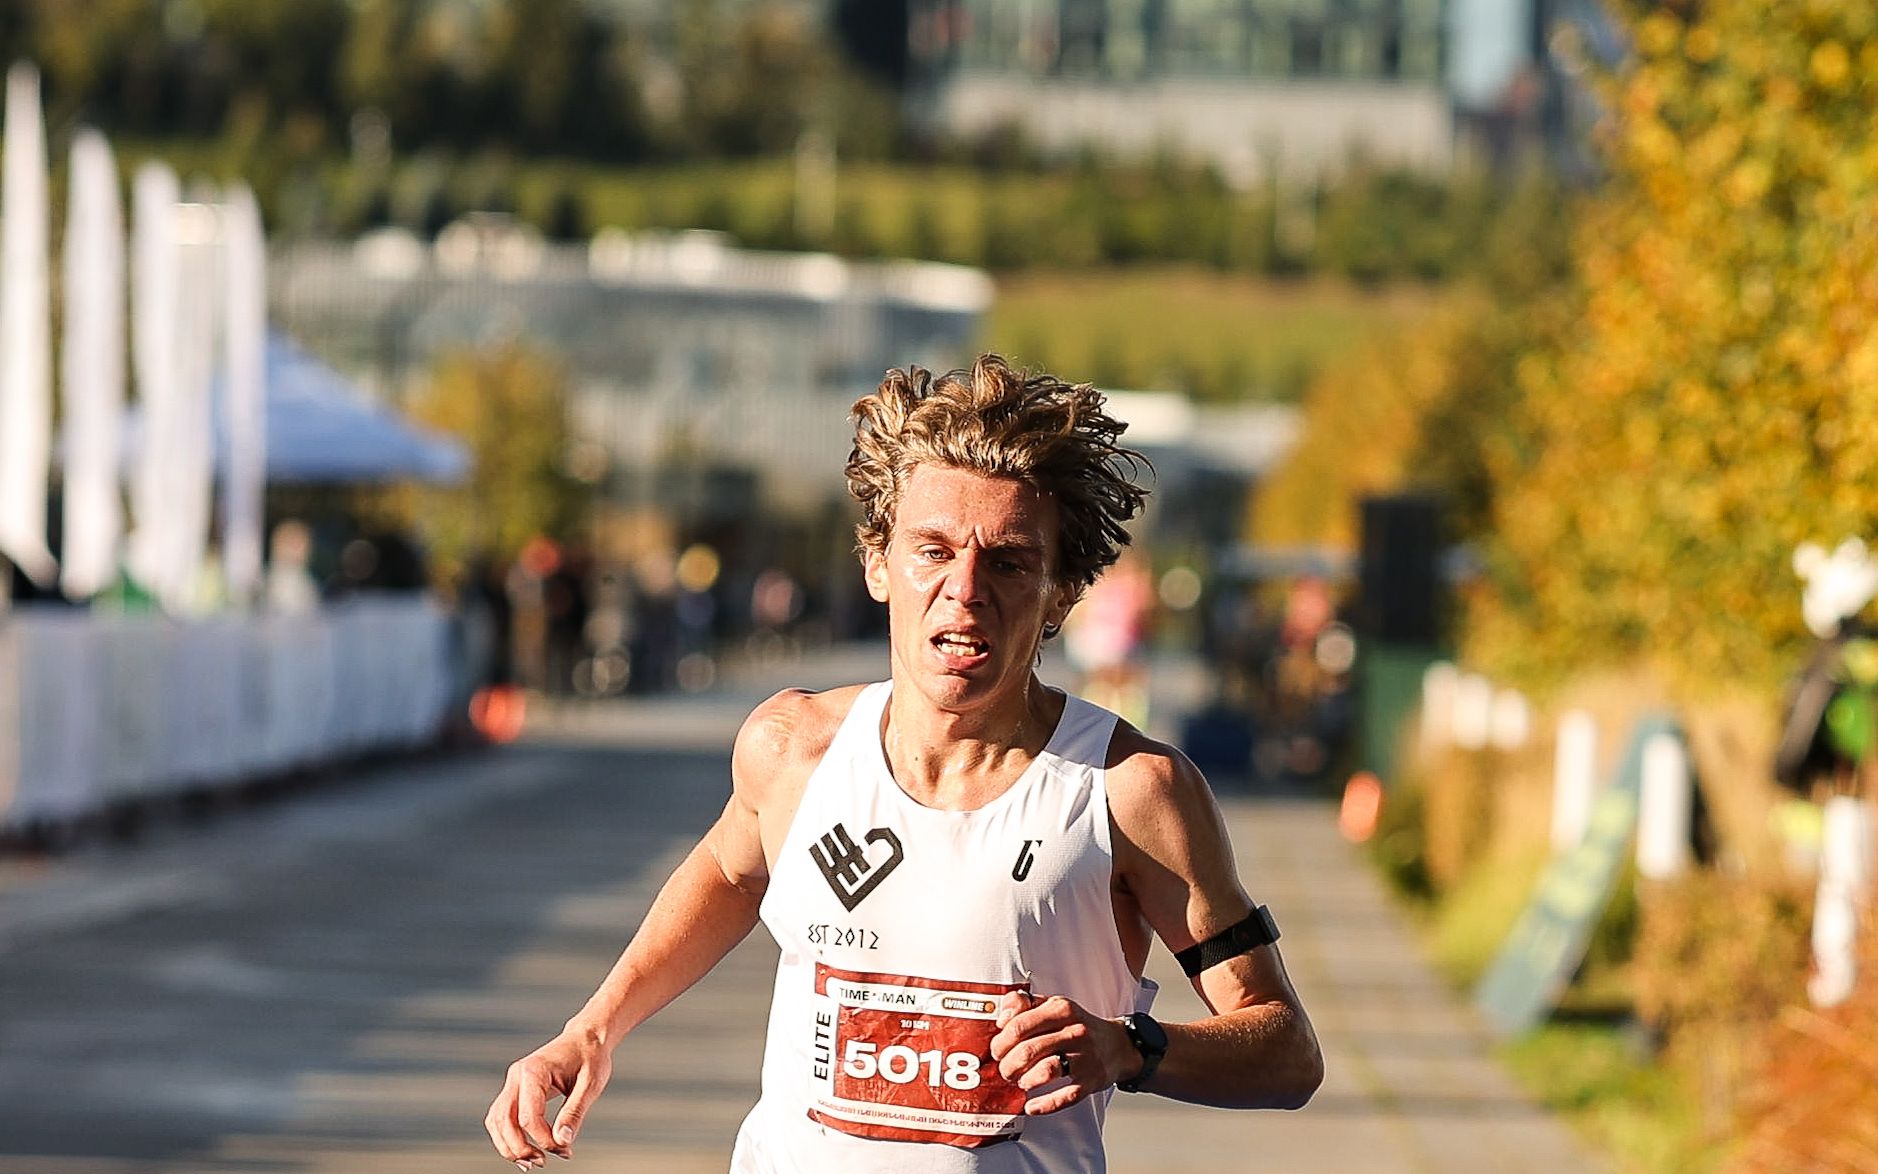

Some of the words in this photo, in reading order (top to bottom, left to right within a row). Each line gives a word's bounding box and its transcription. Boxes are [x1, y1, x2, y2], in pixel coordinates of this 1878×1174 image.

[835, 927, 879, 950] 2012
[814, 1011, 831, 1081] ELITE
[843, 1039, 981, 1091] 5018
